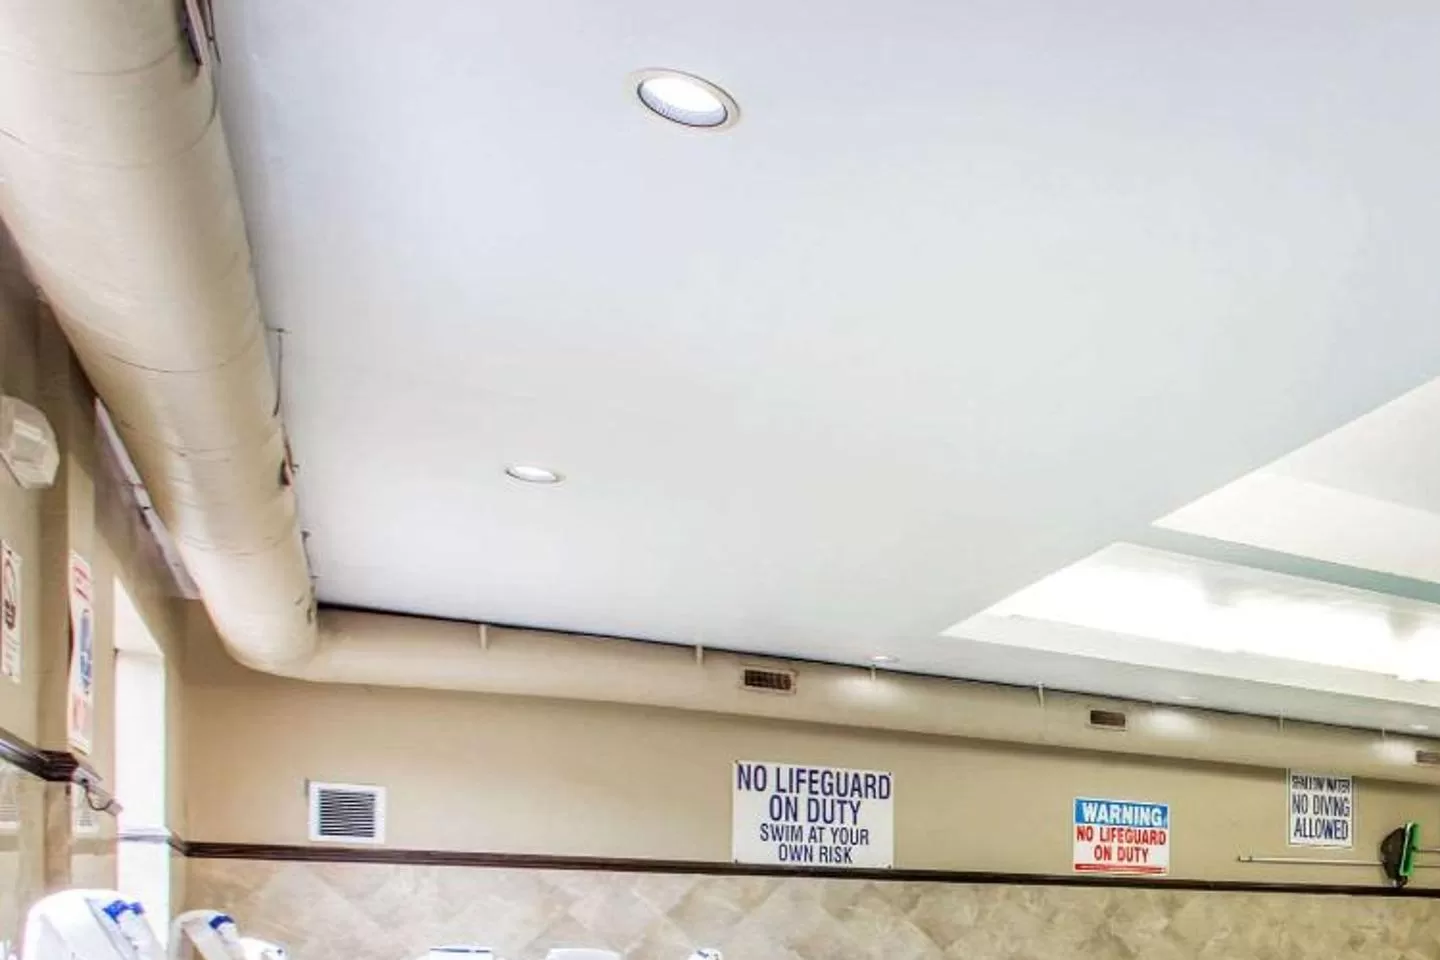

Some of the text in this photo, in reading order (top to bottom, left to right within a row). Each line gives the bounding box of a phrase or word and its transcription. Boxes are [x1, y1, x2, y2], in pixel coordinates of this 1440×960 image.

[737, 764, 891, 800] NO LIFEGUARD
[769, 795, 861, 825] ON DUTY
[1082, 802, 1163, 826] WARNING
[1292, 793, 1350, 817] NO DIVING
[760, 823, 869, 845] SWIM AT YOUR
[1077, 826, 1167, 845] NO LIFEGUARD
[1294, 817, 1349, 840] ALLOWED
[779, 844, 853, 864] OWN RISK
[1094, 845, 1149, 863] ON DUTY
